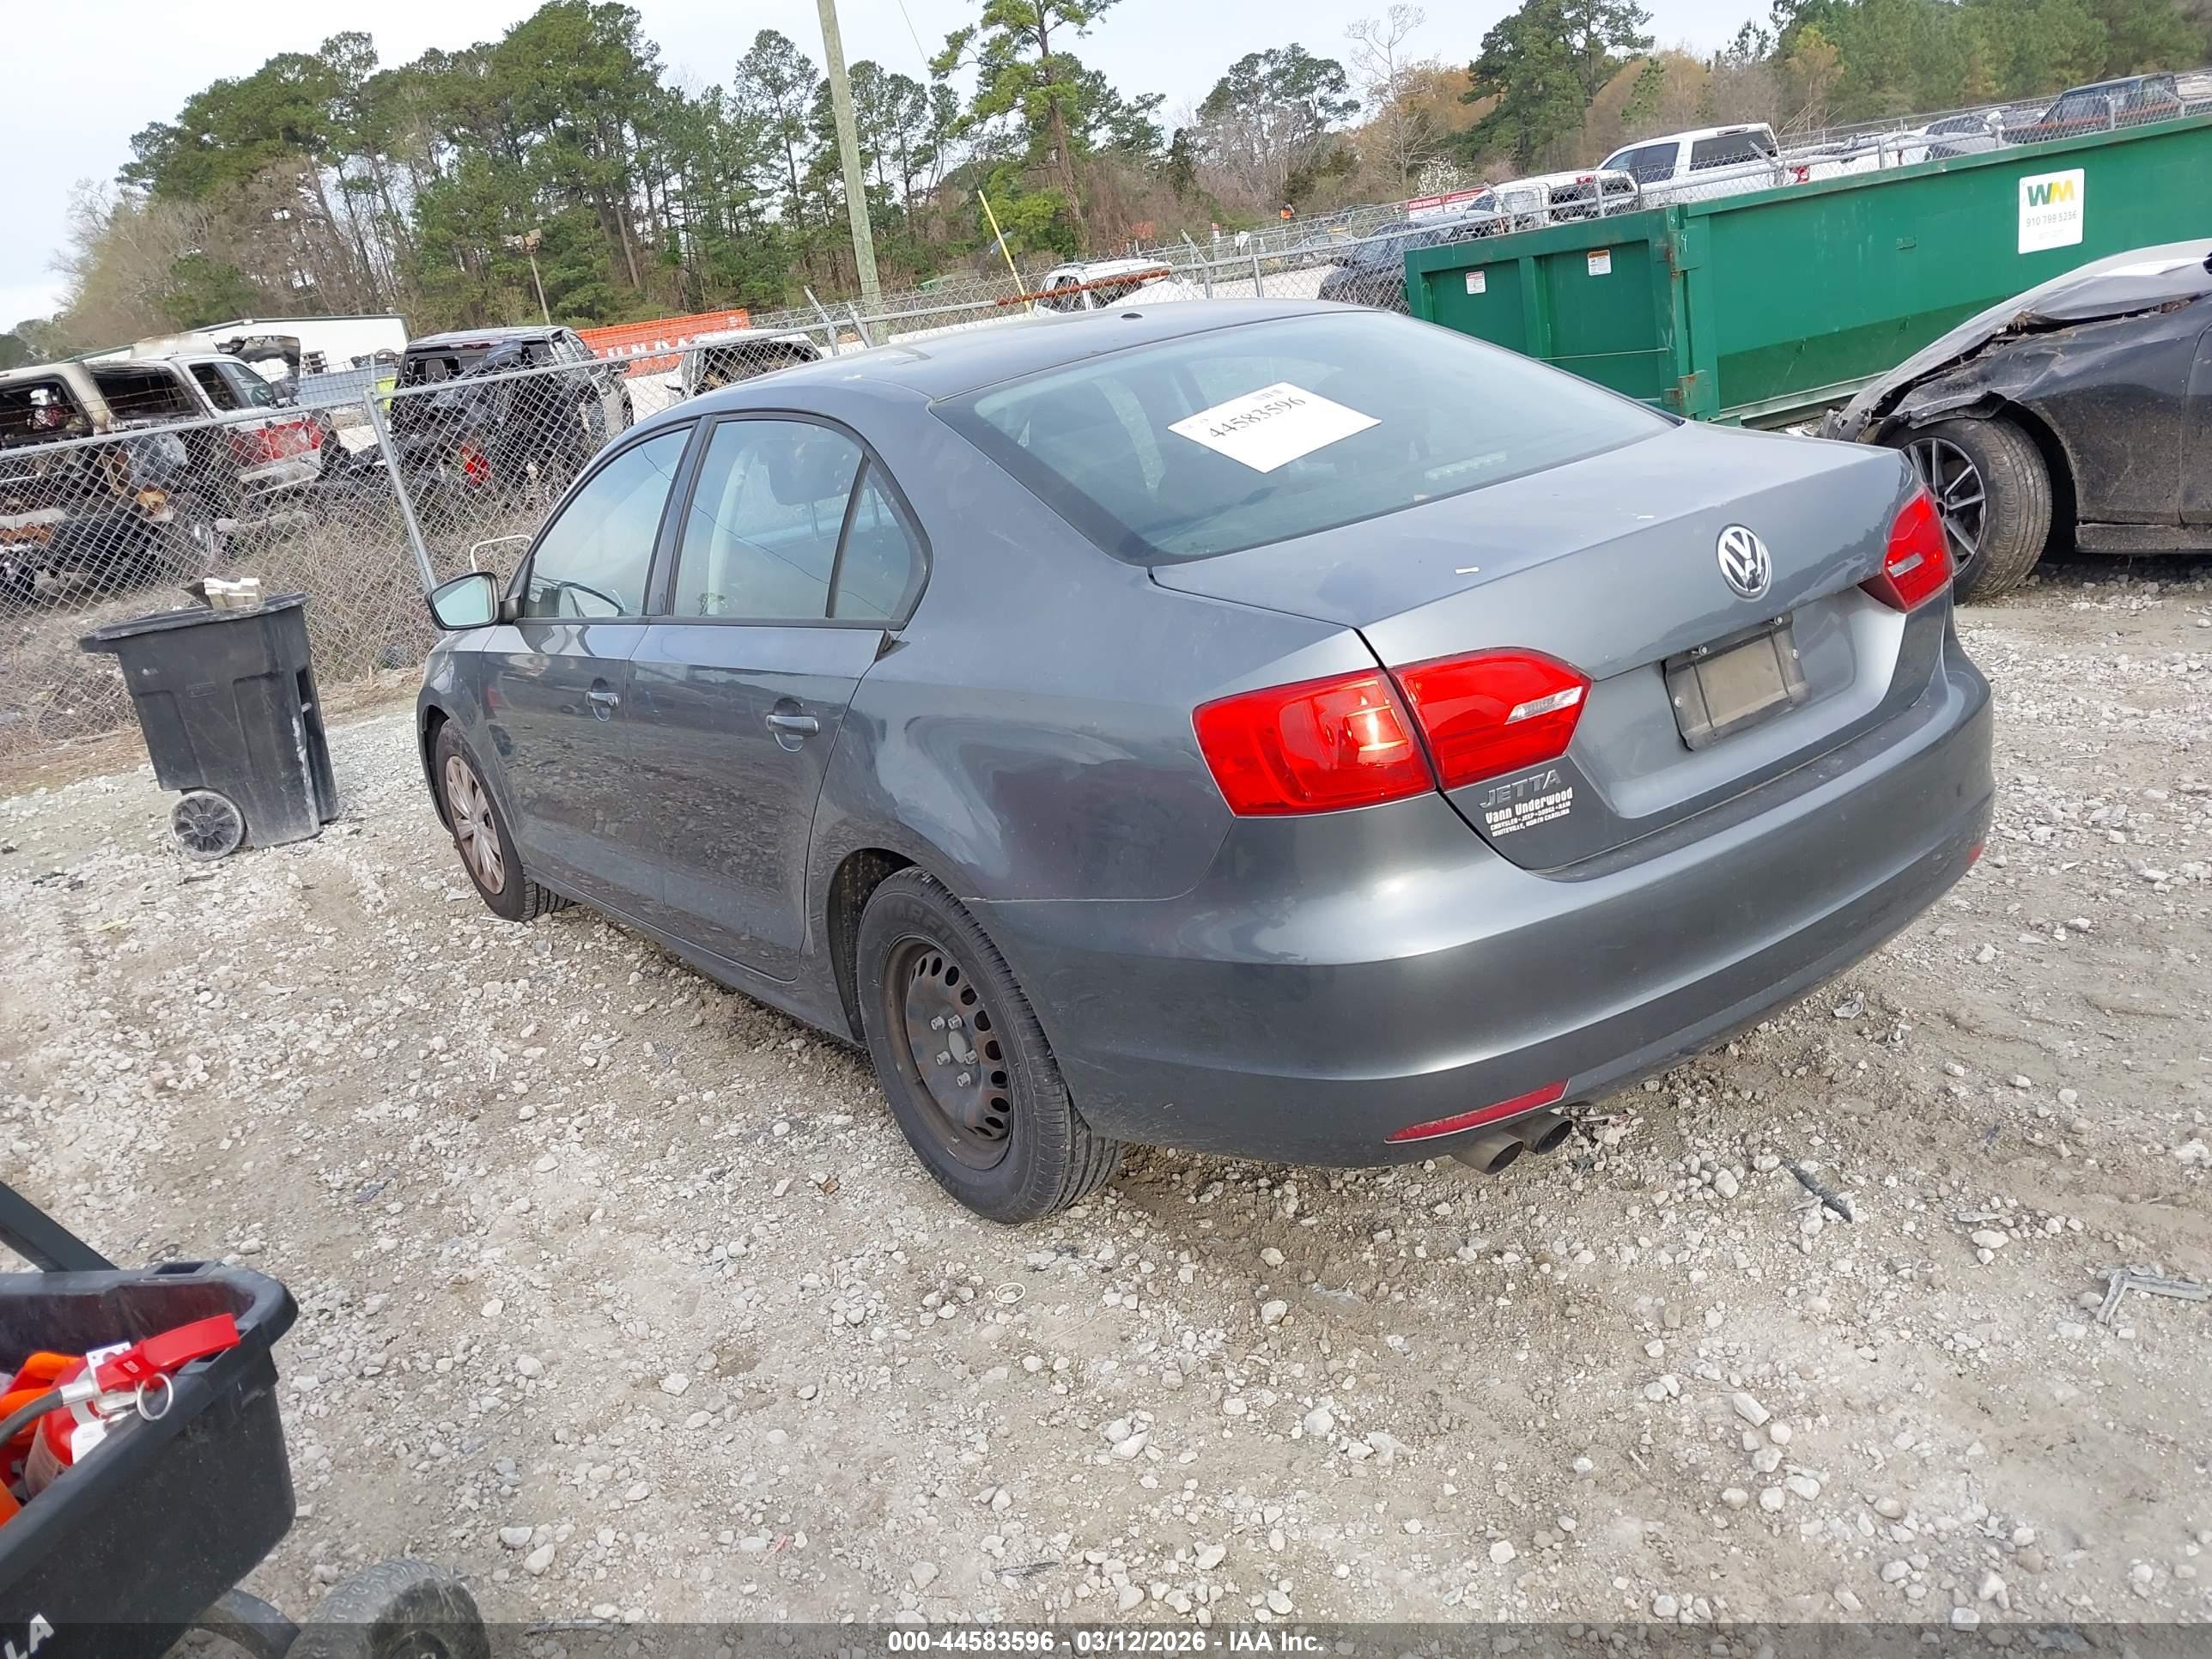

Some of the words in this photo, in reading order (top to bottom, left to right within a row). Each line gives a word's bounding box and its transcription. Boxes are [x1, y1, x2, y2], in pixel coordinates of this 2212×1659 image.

[2027, 179, 2075, 207] WM
[2026, 216, 2041, 228] 910
[2042, 213, 2057, 224] 799
[1209, 396, 1306, 438] 44583596
[1479, 769, 1562, 809] JETTA
[1485, 807, 1512, 824] Vann
[1514, 787, 1573, 816] Underwood
[1490, 817, 1518, 830] CHRYSLER
[1522, 812, 1534, 822] JEEP
